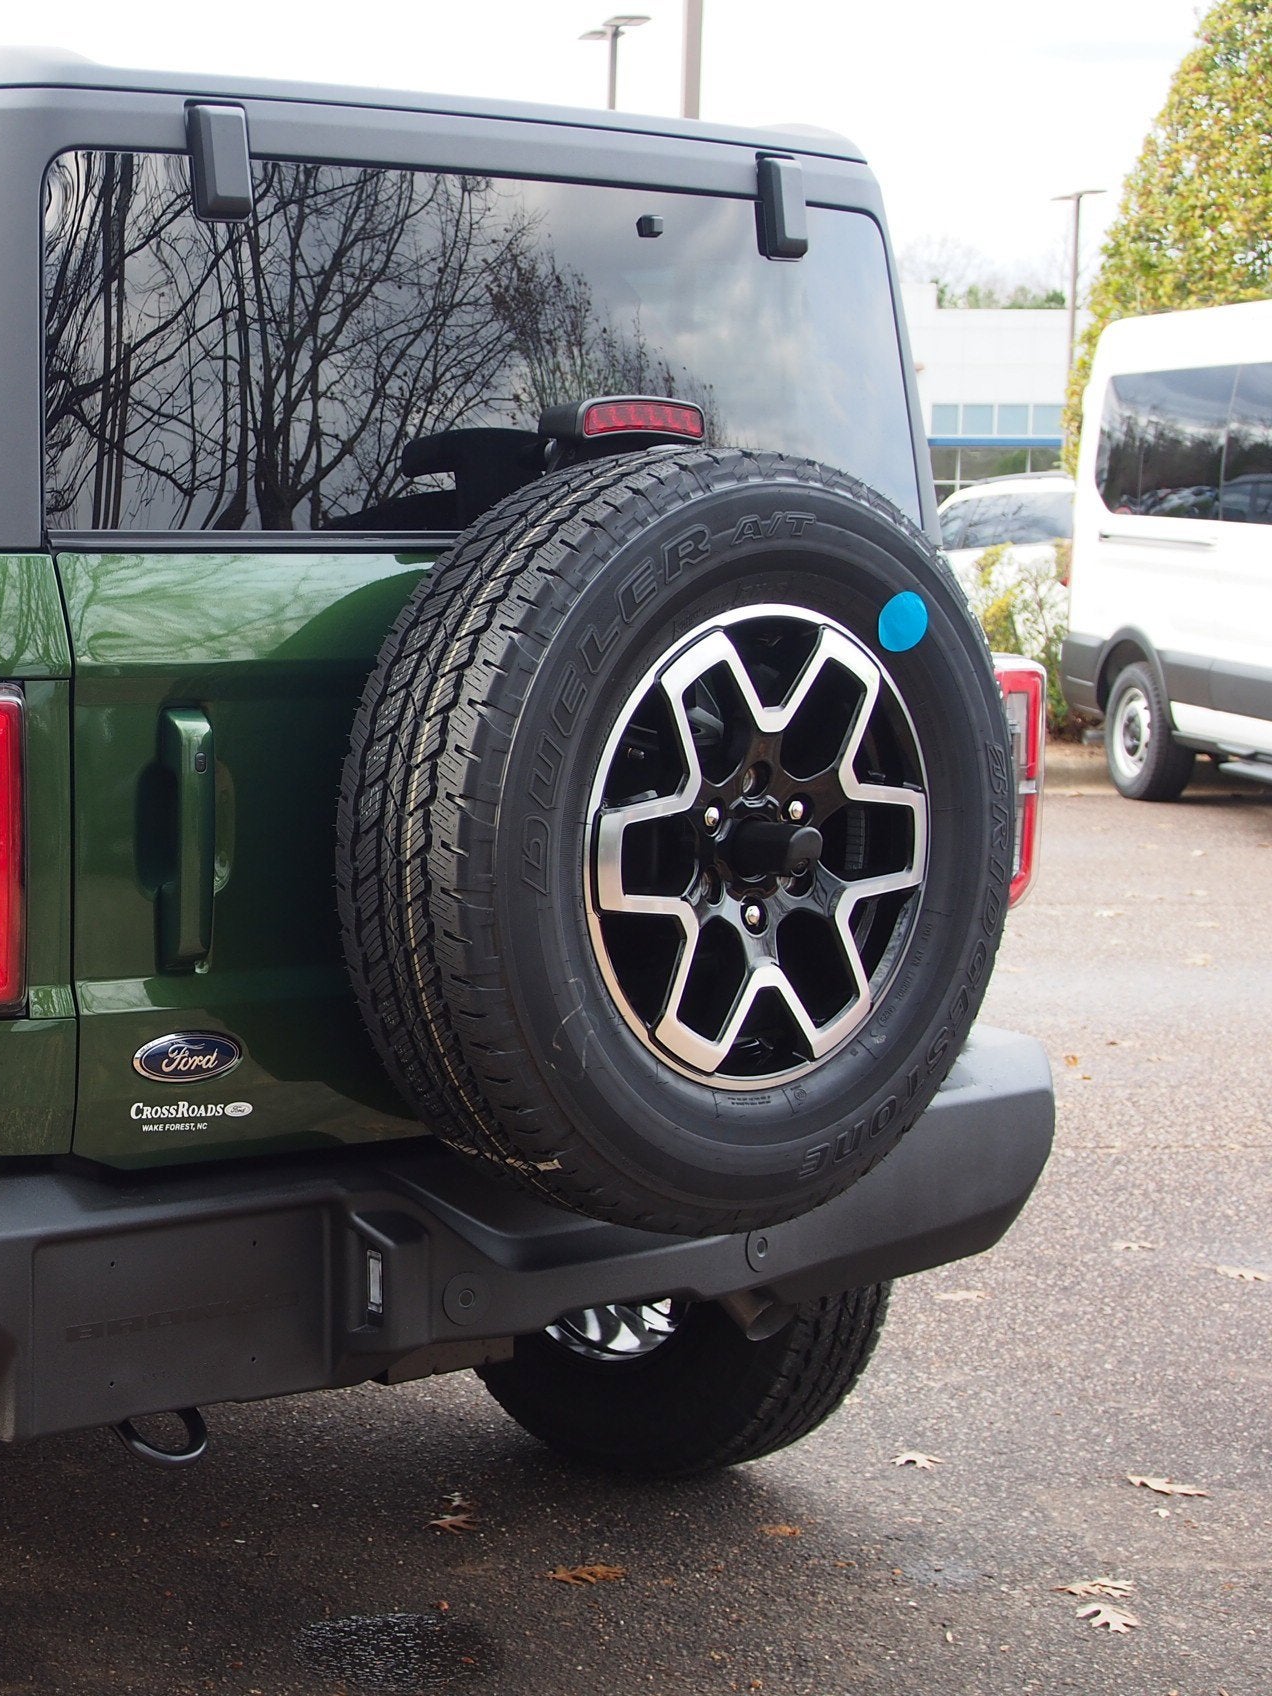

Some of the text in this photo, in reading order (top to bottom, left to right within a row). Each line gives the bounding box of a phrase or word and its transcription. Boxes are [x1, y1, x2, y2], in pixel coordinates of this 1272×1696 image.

[524, 512, 815, 896] DUELER A/T
[163, 1042, 218, 1073] Ford
[799, 742, 1009, 1179] BRIDGESTONE
[142, 1122, 208, 1132] WAKE FOREST, NC
